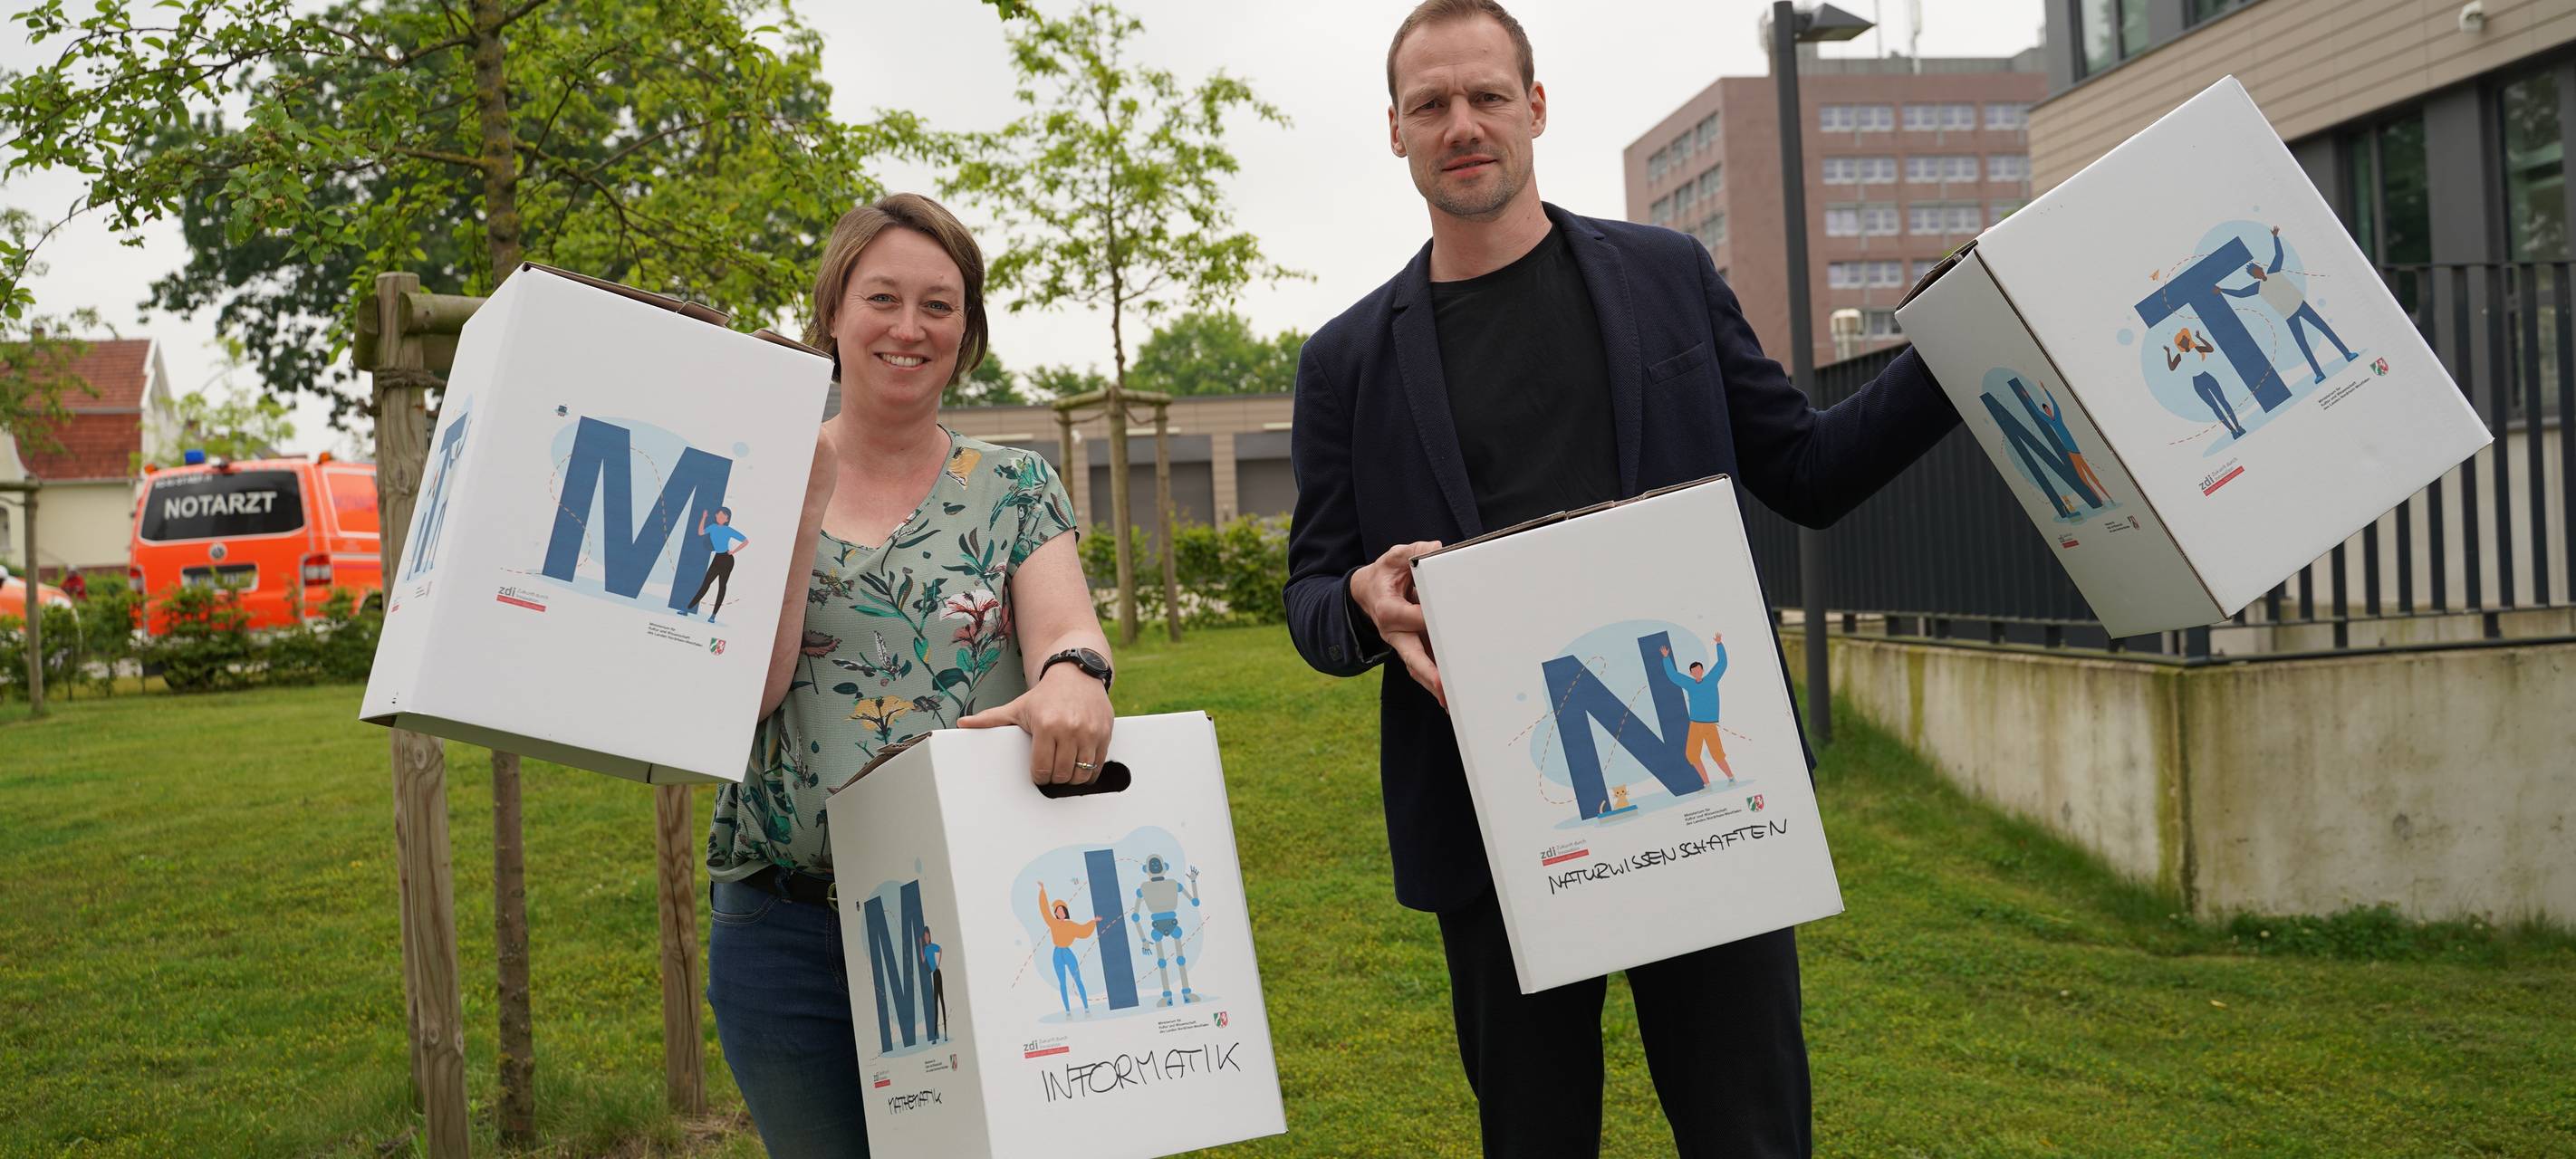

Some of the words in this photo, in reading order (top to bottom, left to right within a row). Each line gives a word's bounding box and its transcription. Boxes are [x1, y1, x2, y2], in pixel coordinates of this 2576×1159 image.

[2198, 474, 2215, 491] zdi
[164, 491, 277, 521] NOTARZT
[543, 416, 733, 614] M
[498, 586, 516, 598] zdi
[1542, 630, 1706, 820] N
[1540, 847, 1557, 859] zdi
[1548, 819, 1787, 895] NATURWISSENSCHAFTEN
[864, 880, 939, 1053] M
[1024, 1039, 1038, 1052] zdi
[1042, 1042, 1240, 1102] INFORMATIK
